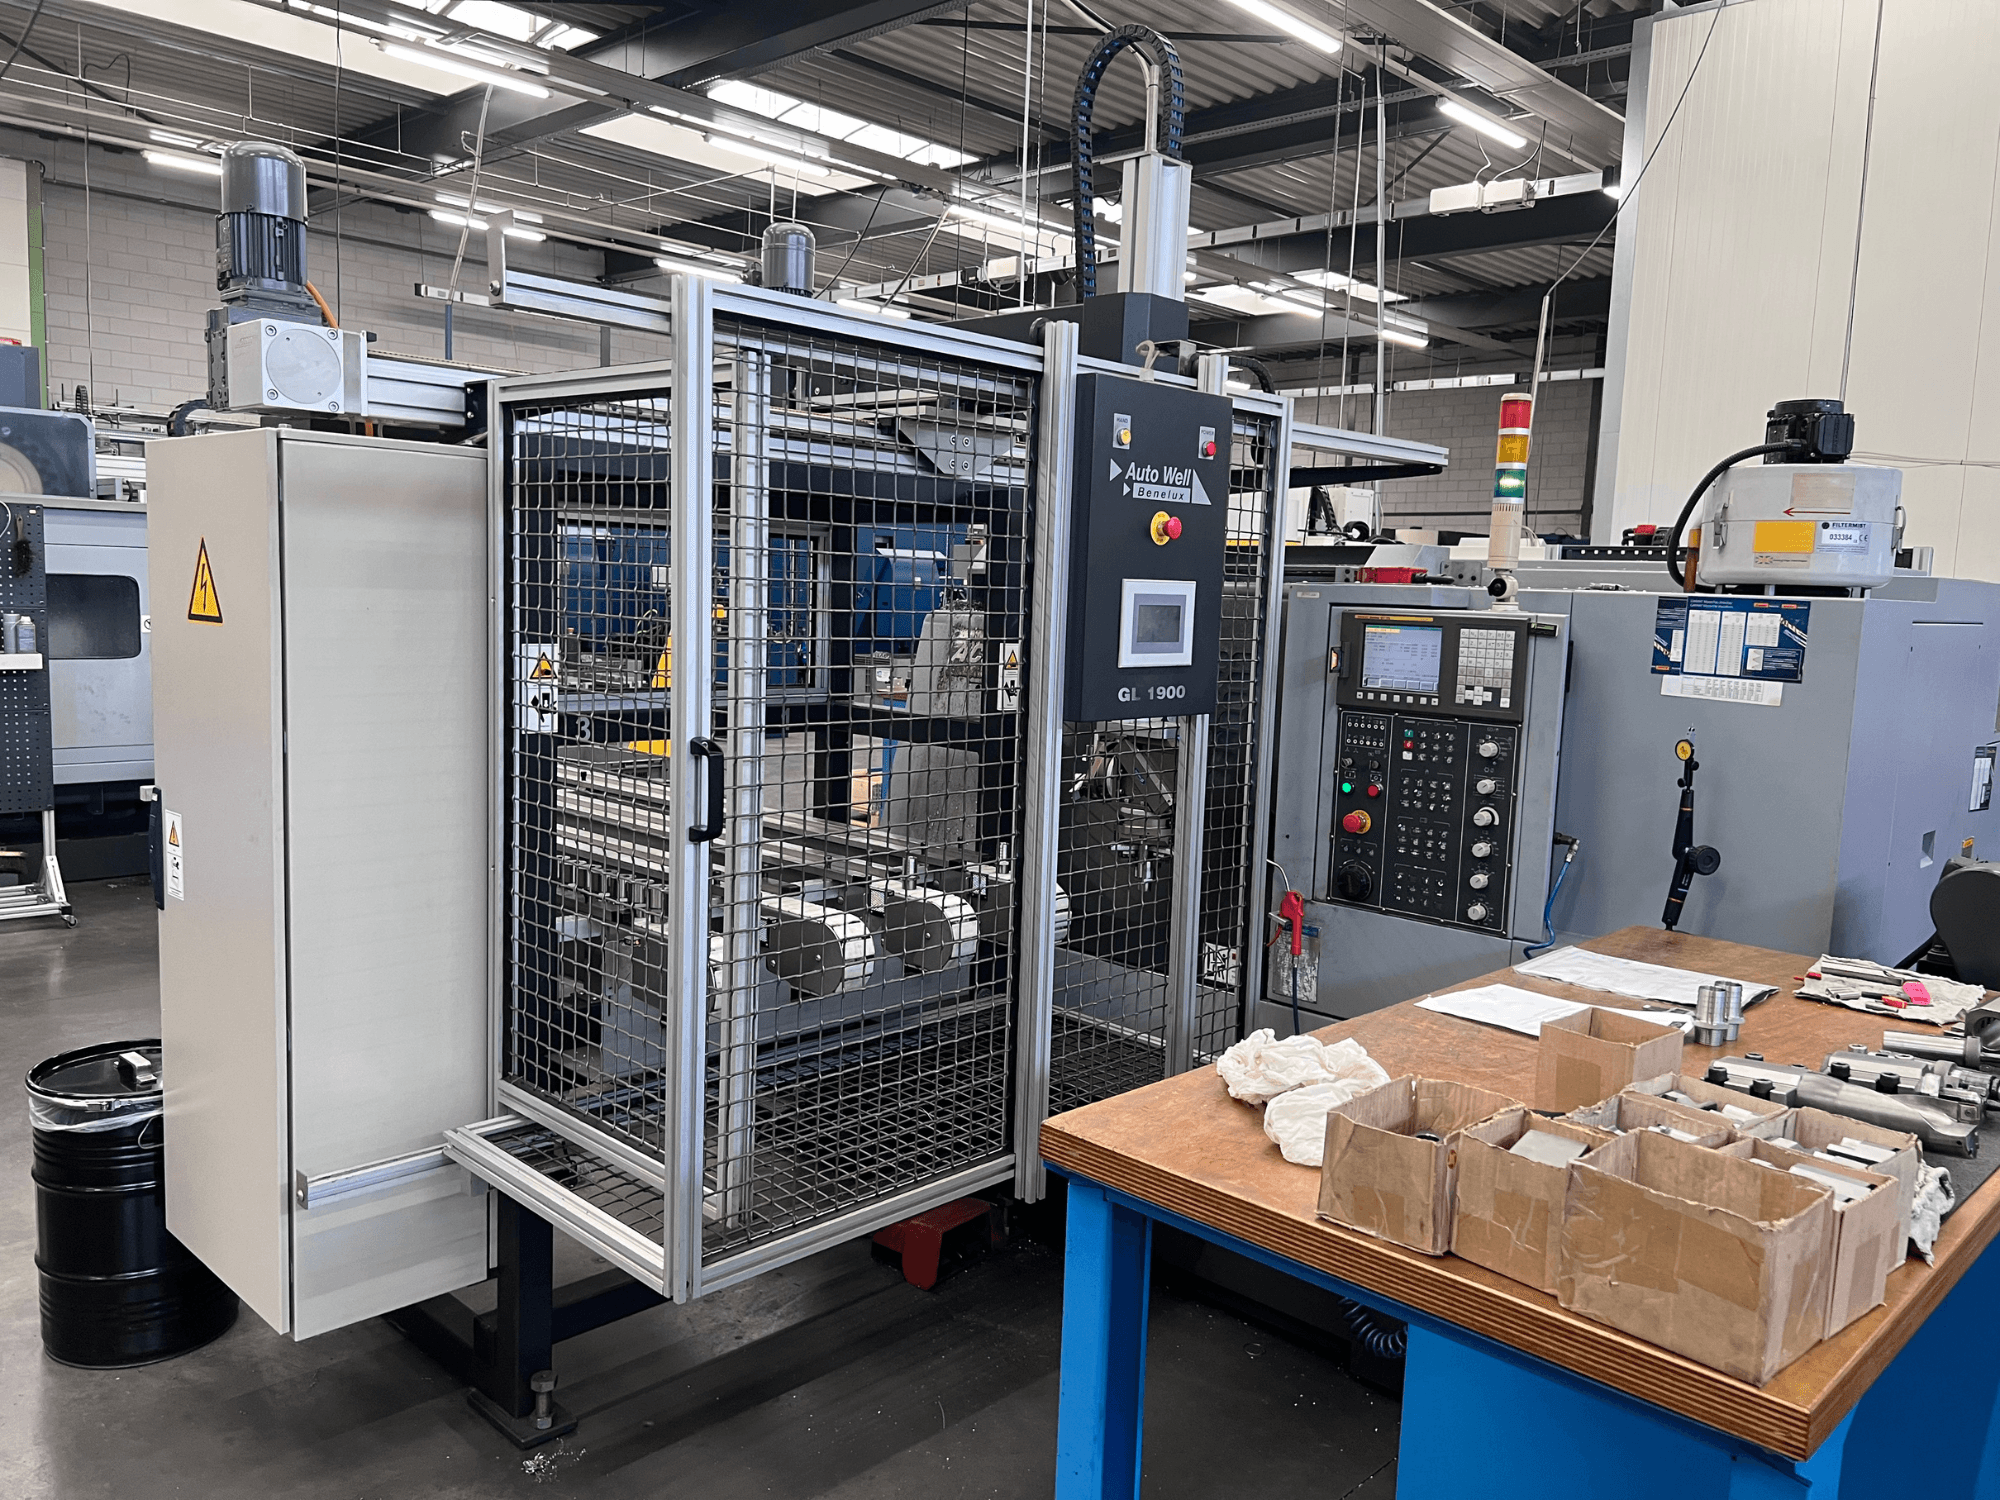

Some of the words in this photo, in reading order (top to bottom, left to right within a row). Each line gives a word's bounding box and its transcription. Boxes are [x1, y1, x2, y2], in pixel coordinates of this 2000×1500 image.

[1125, 461, 1159, 483] Auto
[1163, 466, 1192, 486] Well
[1138, 487, 1185, 501] Benelux
[1117, 687, 1141, 702] GL
[1147, 684, 1186, 700] 1900
[575, 716, 591, 741] 3
